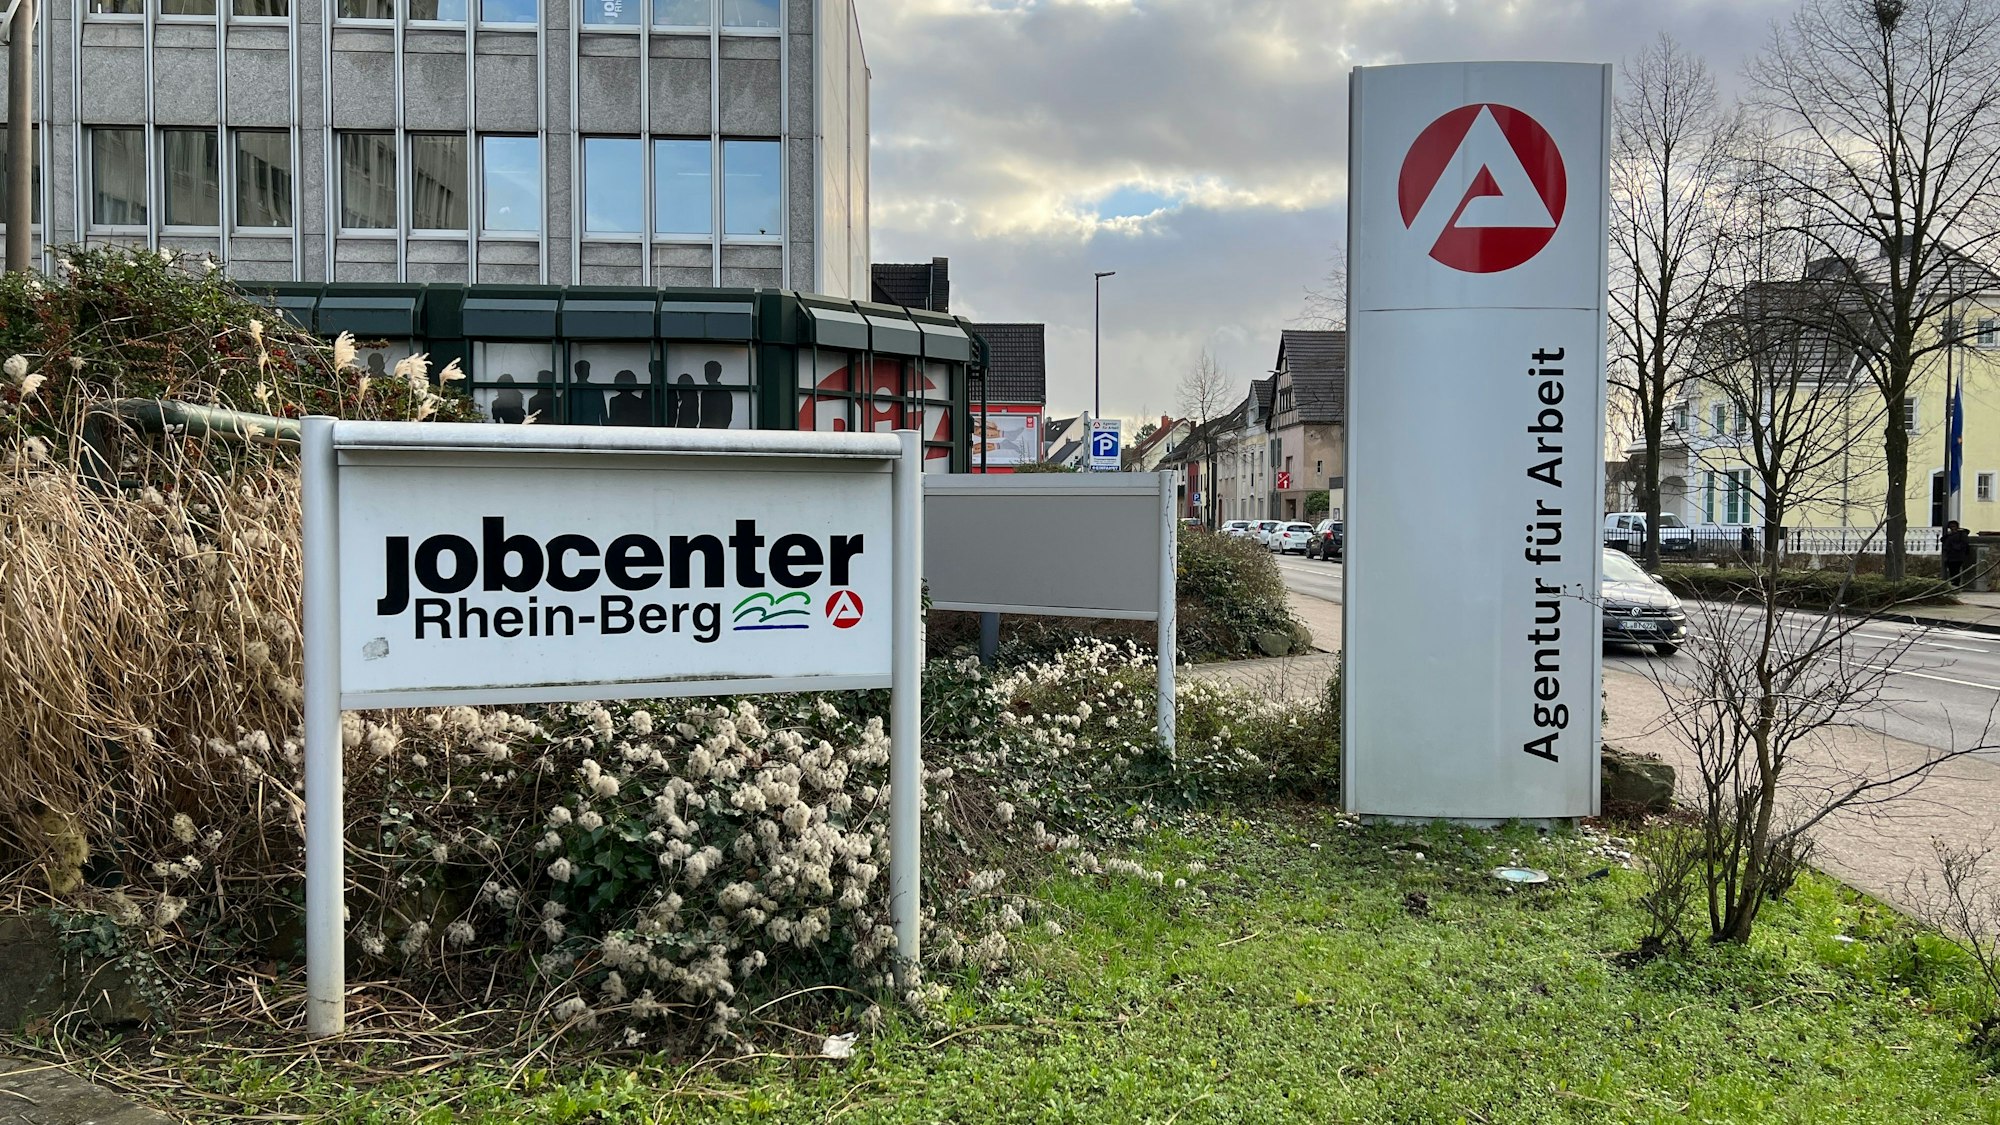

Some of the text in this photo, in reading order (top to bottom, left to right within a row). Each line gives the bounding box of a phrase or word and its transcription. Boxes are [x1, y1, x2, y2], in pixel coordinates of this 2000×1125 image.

[1100, 439, 1113, 456] P
[378, 517, 863, 615] jobcenter
[1524, 348, 1568, 762] Agentur für Arbeit
[416, 595, 721, 644] Rhein-Berg
